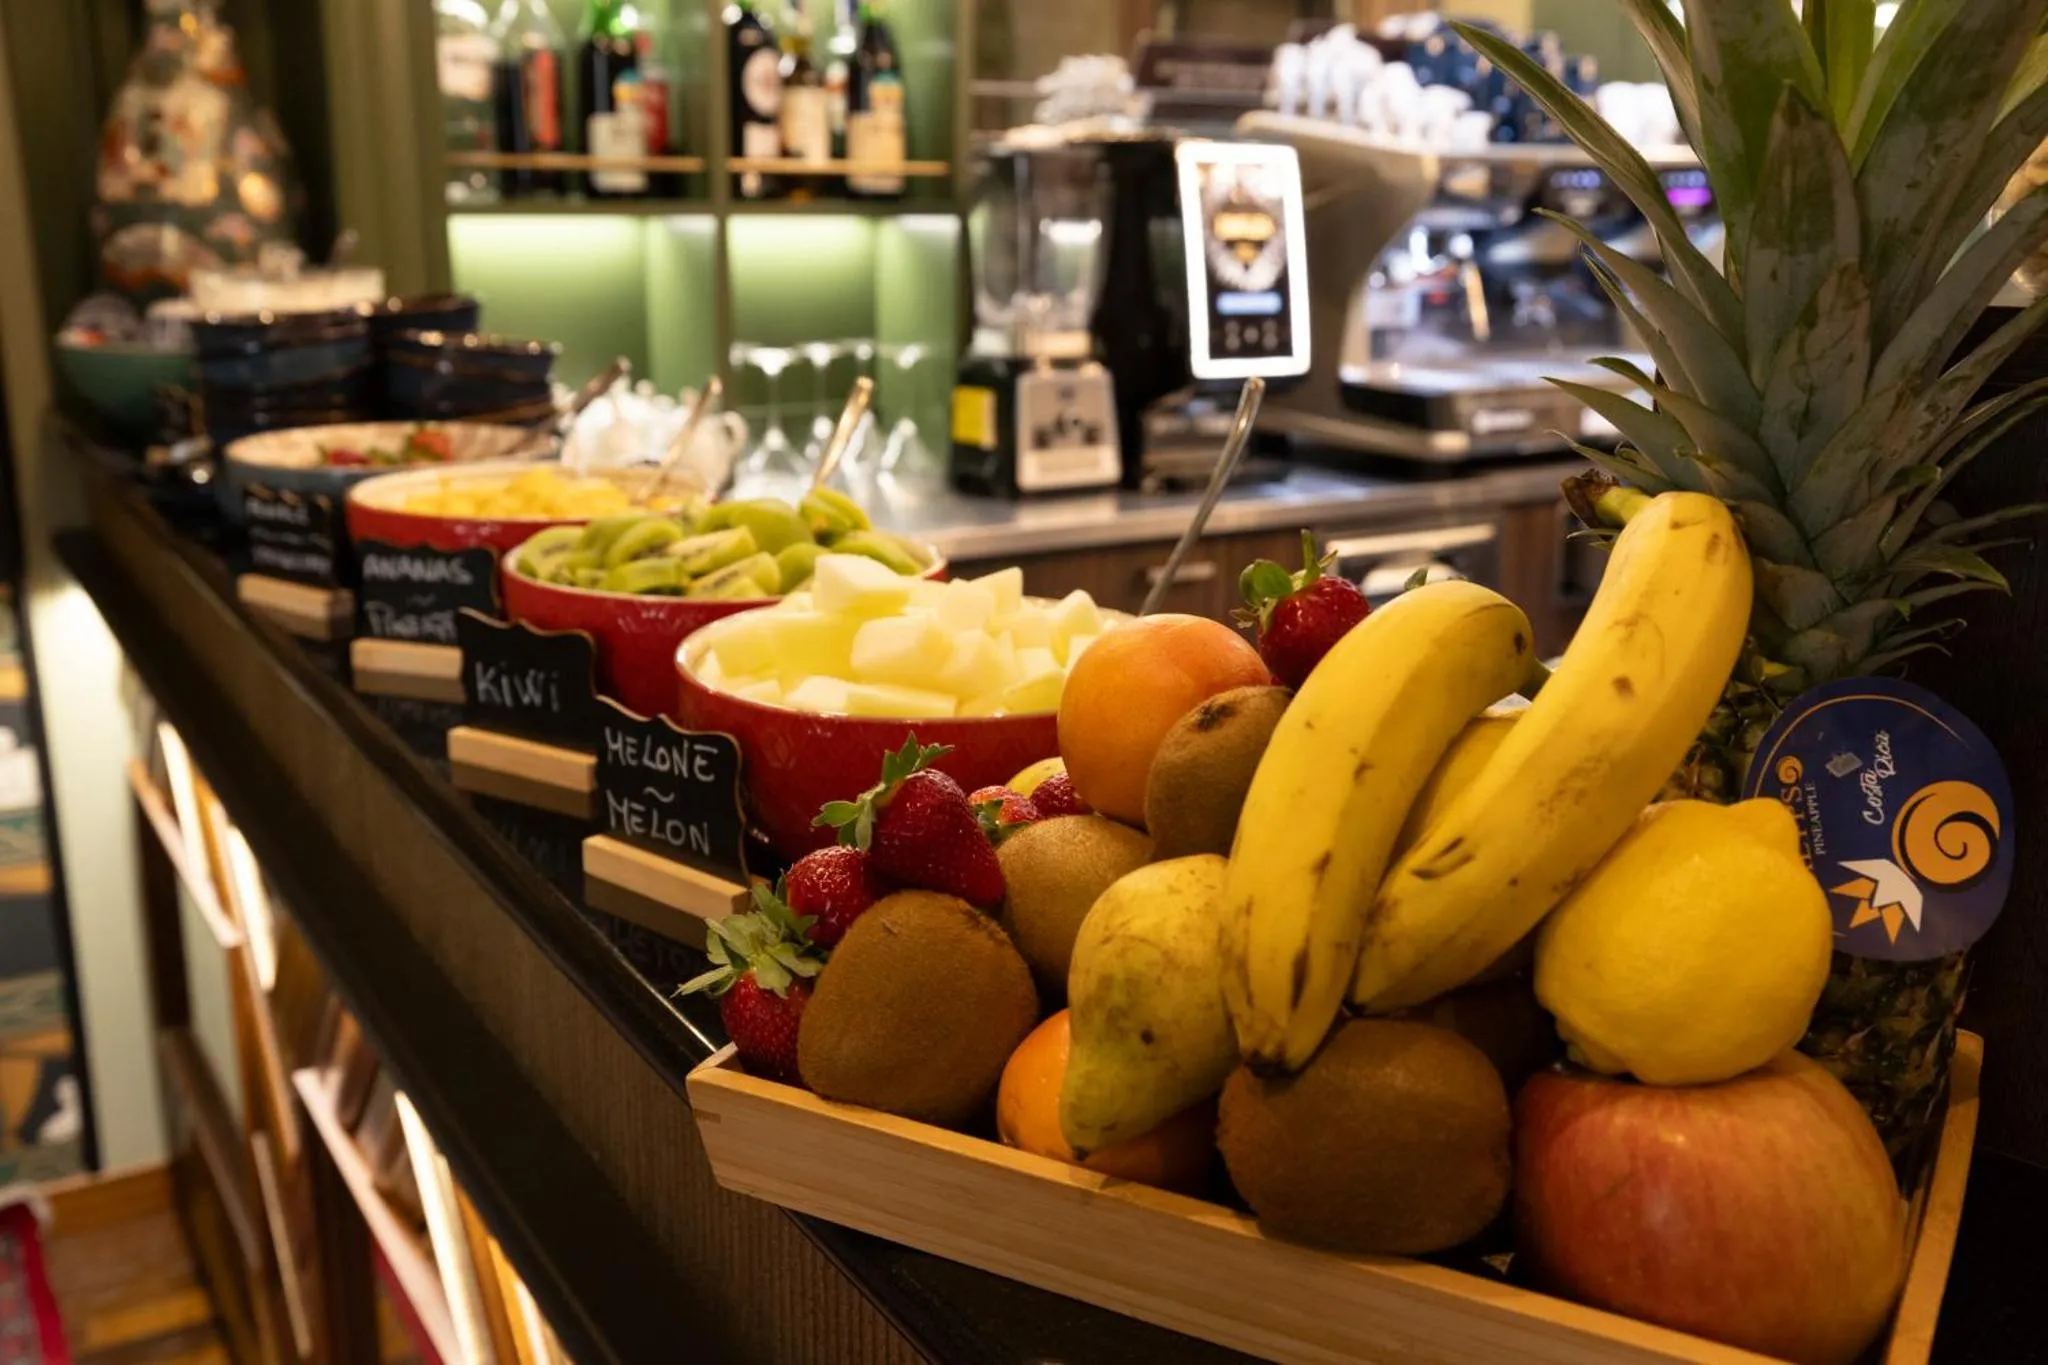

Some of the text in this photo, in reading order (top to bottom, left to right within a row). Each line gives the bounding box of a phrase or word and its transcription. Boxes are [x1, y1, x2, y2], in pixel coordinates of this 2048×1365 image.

[604, 726, 719, 782] MELONE
[605, 789, 710, 856] MELON
[1804, 780, 1827, 855] PINEAPPLE
[1860, 769, 1885, 825] Costa
